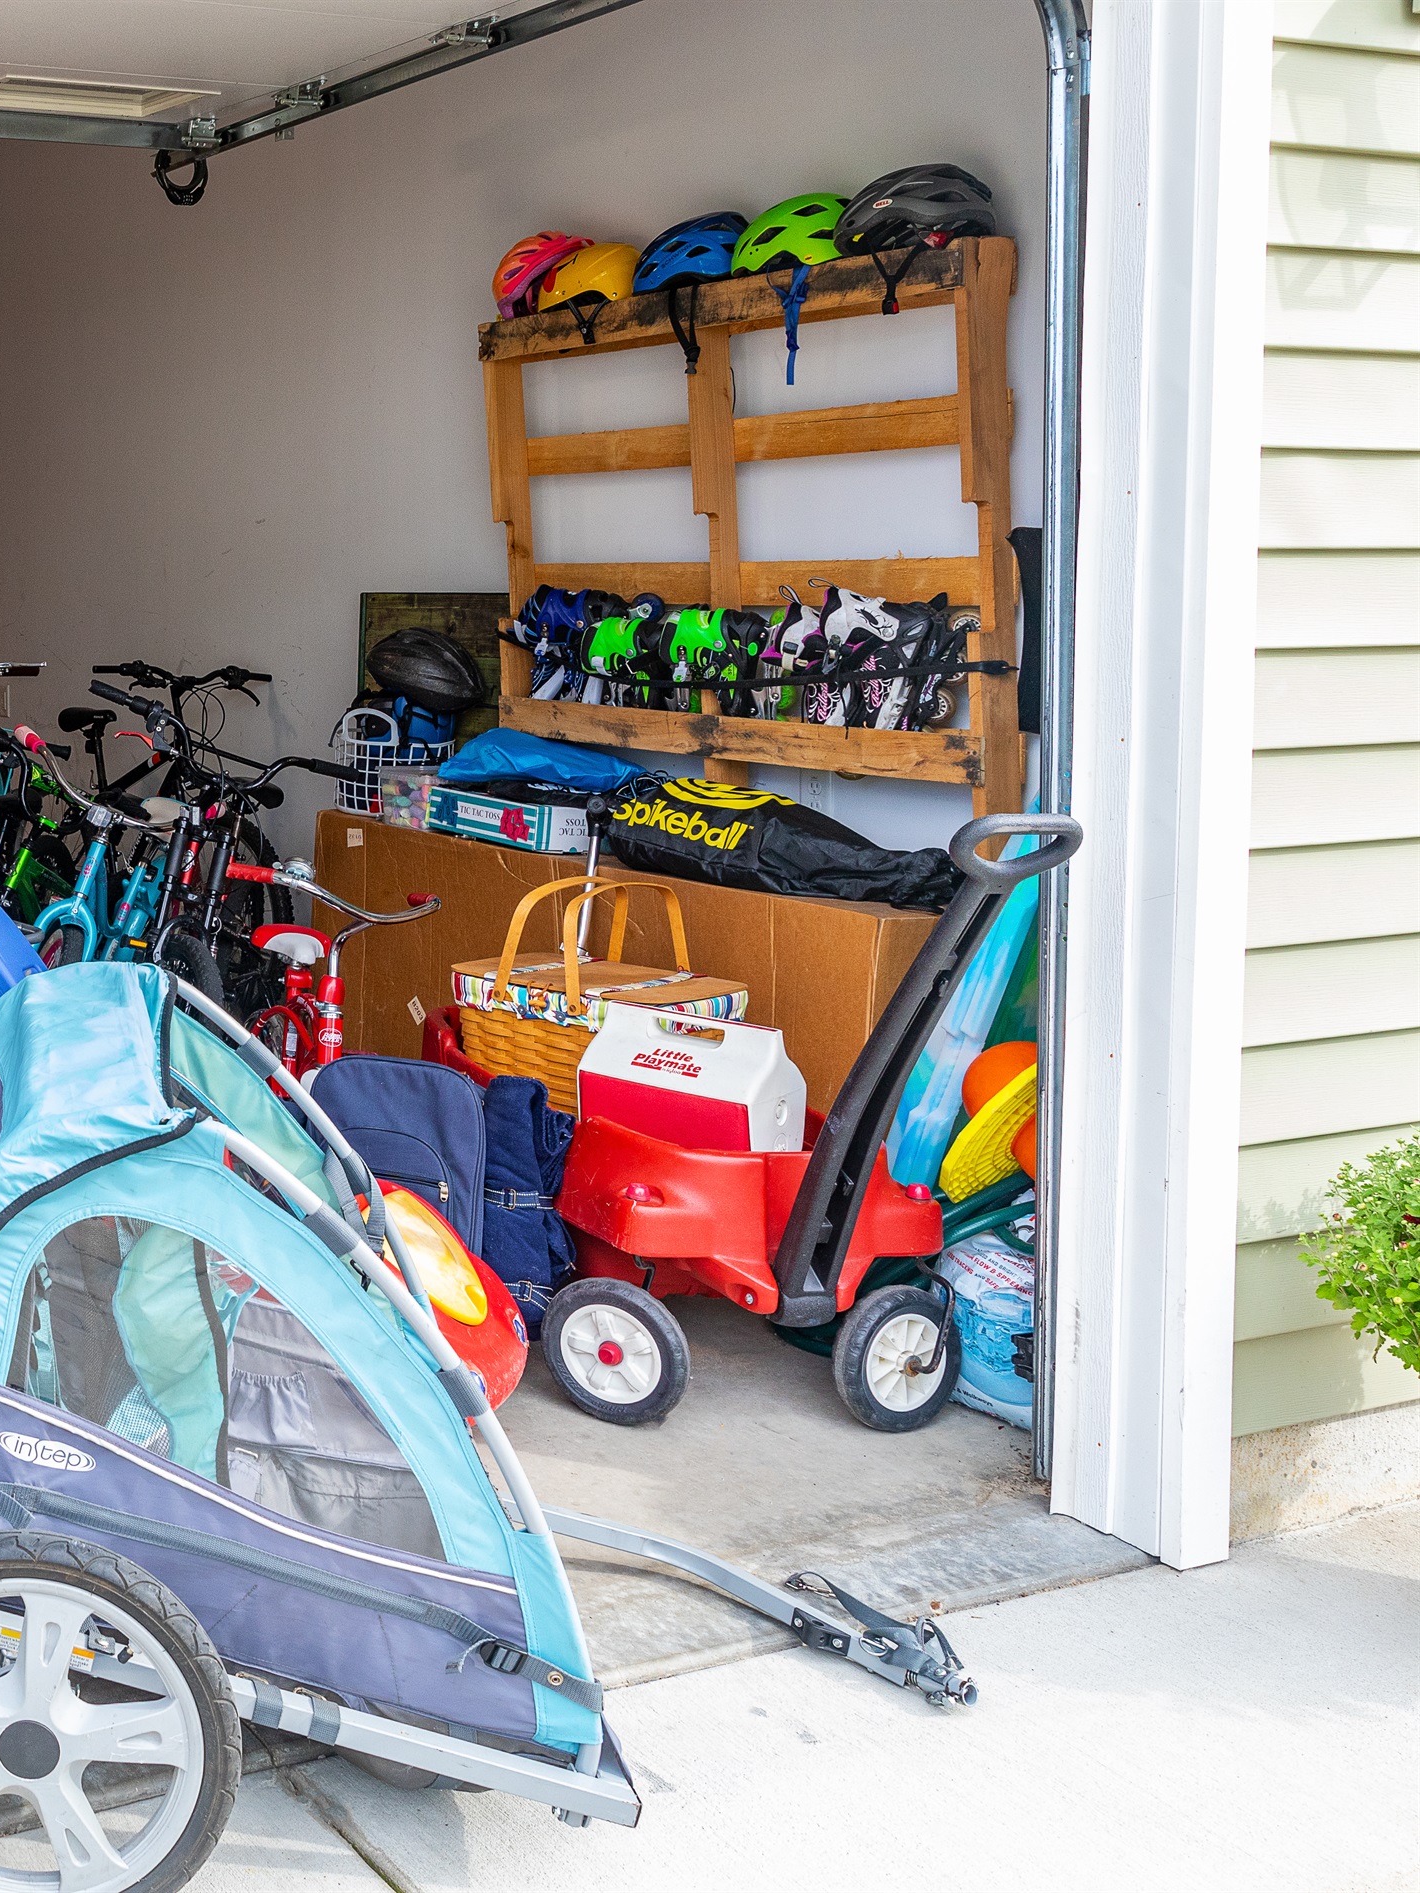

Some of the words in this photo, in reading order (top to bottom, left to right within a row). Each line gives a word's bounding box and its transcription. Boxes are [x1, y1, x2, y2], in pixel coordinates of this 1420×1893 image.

[875, 200, 890, 208] BELL
[461, 806, 471, 815] TIC
[472, 807, 483, 818] TAC
[485, 811, 501, 821] TOSS
[565, 818, 586, 827] TOSS
[612, 797, 749, 851] Spikeball
[559, 828, 575, 837] TAC
[652, 1048, 693, 1063] Little
[633, 1053, 702, 1073] Playmate
[973, 1257, 991, 1270] FLOW
[985, 1277, 1000, 1290] SAFE
